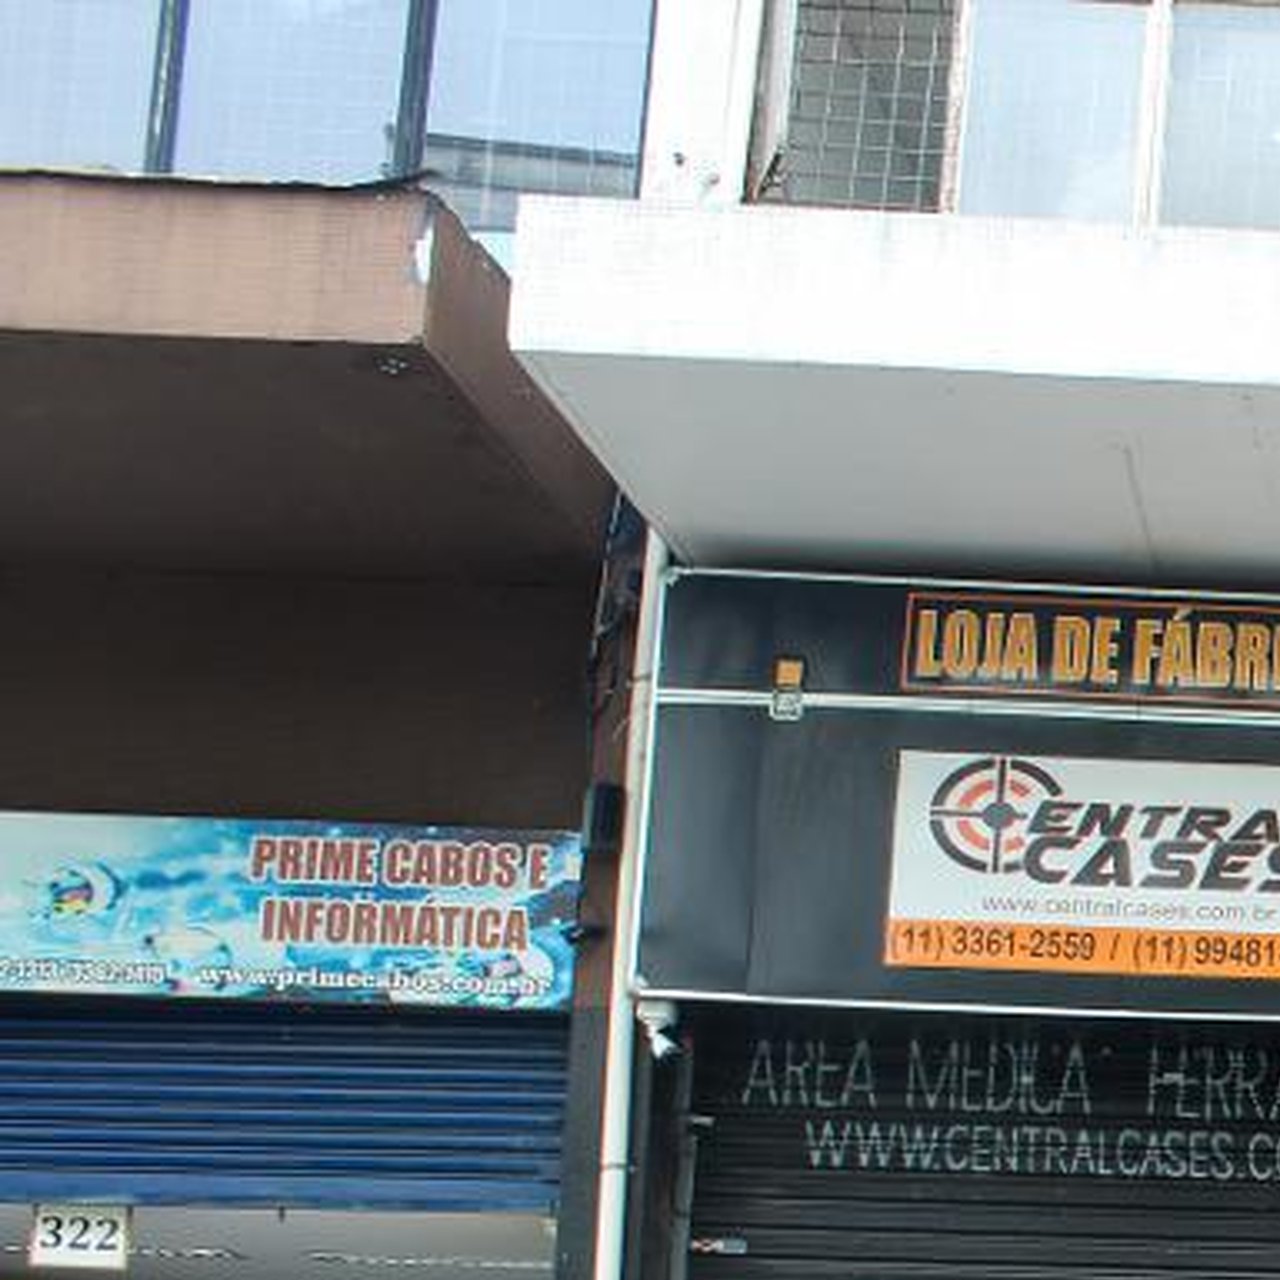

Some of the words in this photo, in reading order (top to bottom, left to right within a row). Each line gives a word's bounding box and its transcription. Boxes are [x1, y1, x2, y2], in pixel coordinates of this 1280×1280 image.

[915, 608, 1039, 682] LOJA
[1051, 615, 1121, 685] DE
[252, 838, 376, 880] PRIME
[385, 841, 518, 888] CABOS
[529, 846, 549, 888] E
[261, 896, 528, 951] INFORMÁTICA
[951, 925, 1097, 961] 3361-2559
[1132, 934, 1189, 970] (11)
[39, 1215, 120, 1252] 322
